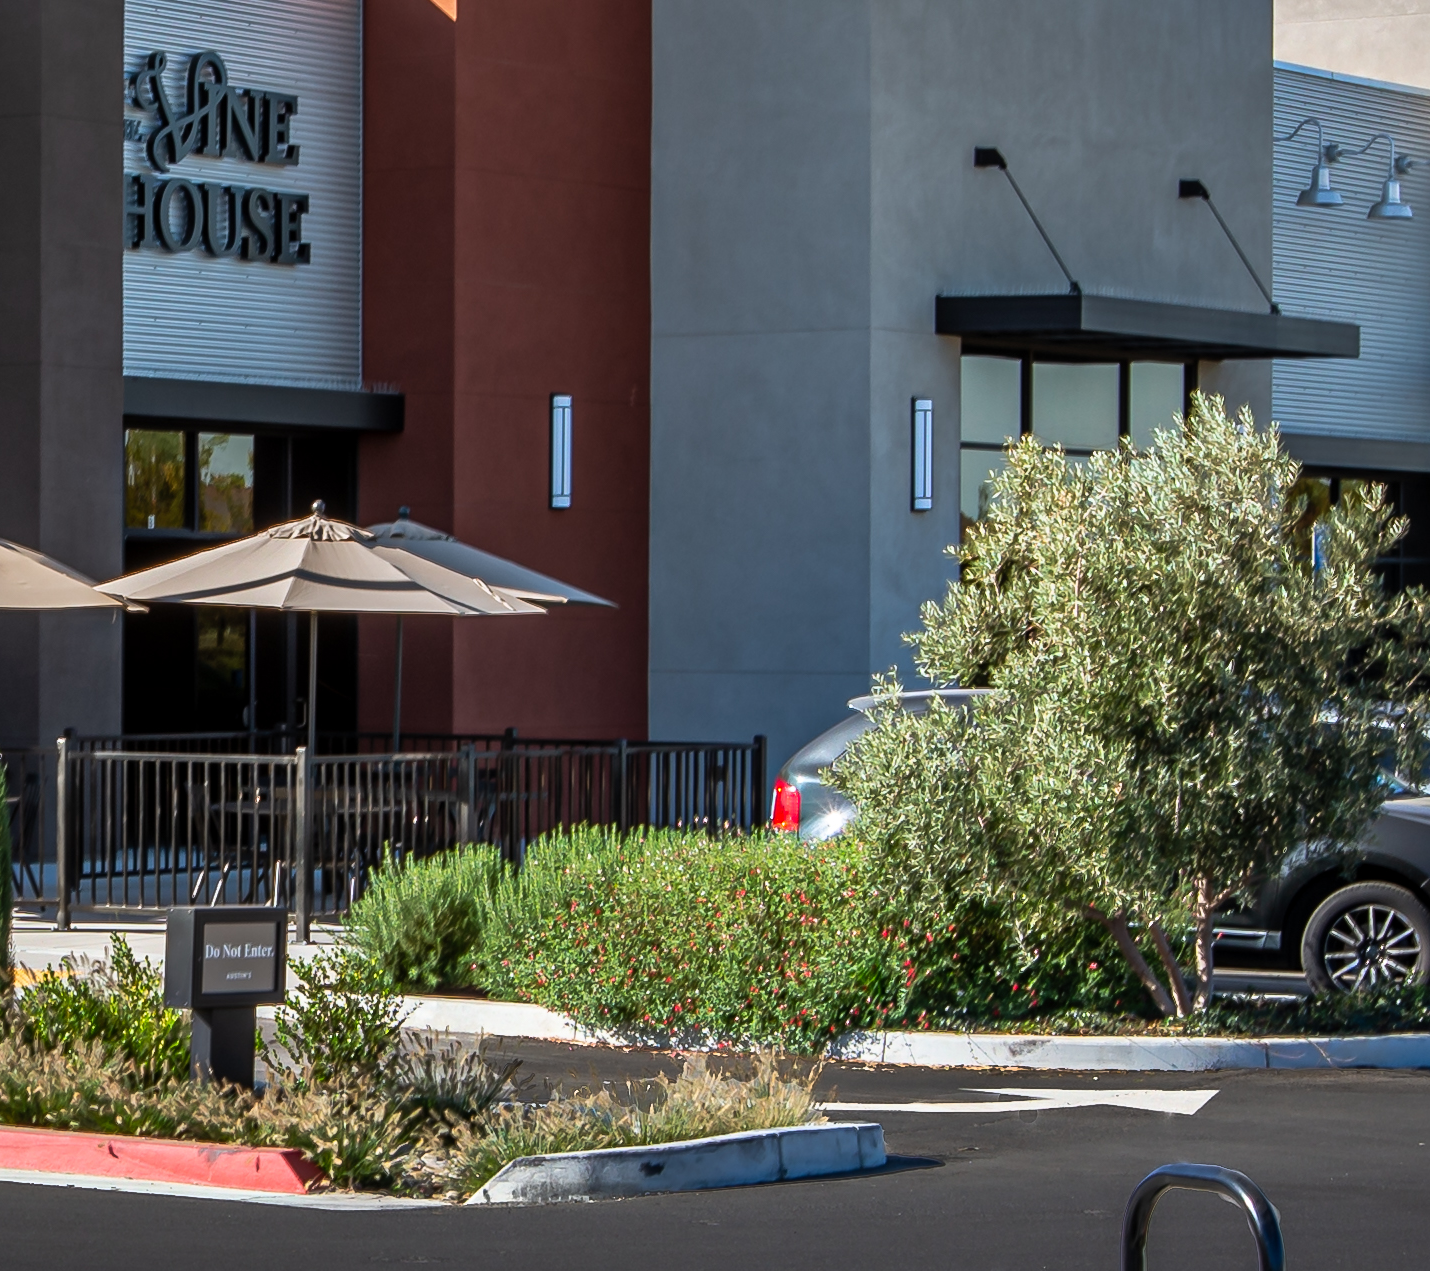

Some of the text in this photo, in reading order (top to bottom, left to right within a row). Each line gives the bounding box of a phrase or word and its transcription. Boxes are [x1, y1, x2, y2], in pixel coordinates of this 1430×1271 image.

[205, 941, 275, 959] Do Not Enter.
